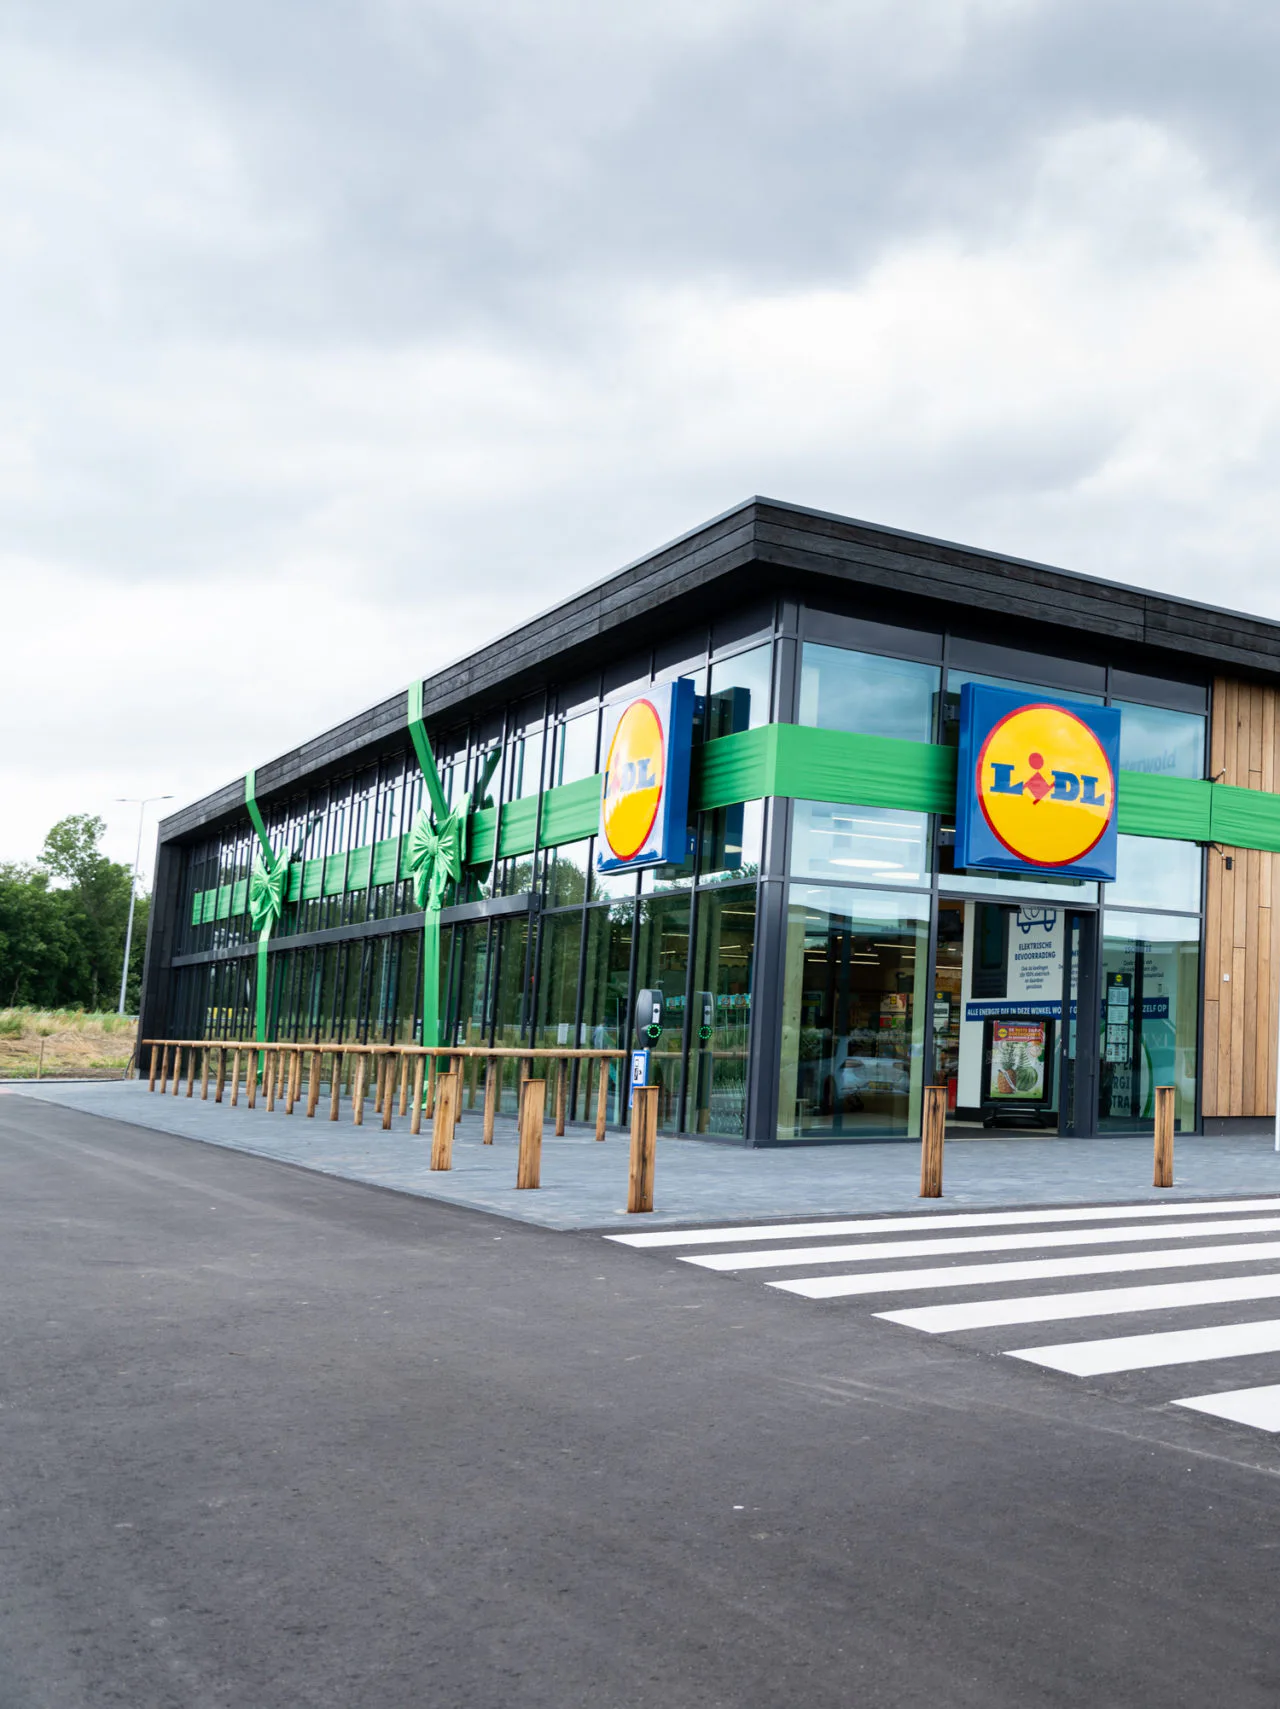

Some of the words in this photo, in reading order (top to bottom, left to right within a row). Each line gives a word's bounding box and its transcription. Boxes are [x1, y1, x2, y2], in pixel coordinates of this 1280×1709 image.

[1018, 941, 1052, 951] ELEKTRISCHE
[1014, 951, 1056, 960] BEVOORRADING
[967, 1008, 978, 1016] ALLE
[979, 1008, 1000, 1016] ENERGIE
[1000, 1007, 1009, 1015] DIE
[1017, 1007, 1030, 1015] DEZE
[1031, 1006, 1051, 1014] WINKEL
[1142, 1005, 1157, 1013] ZELF
[1157, 1004, 1168, 1012] OP
